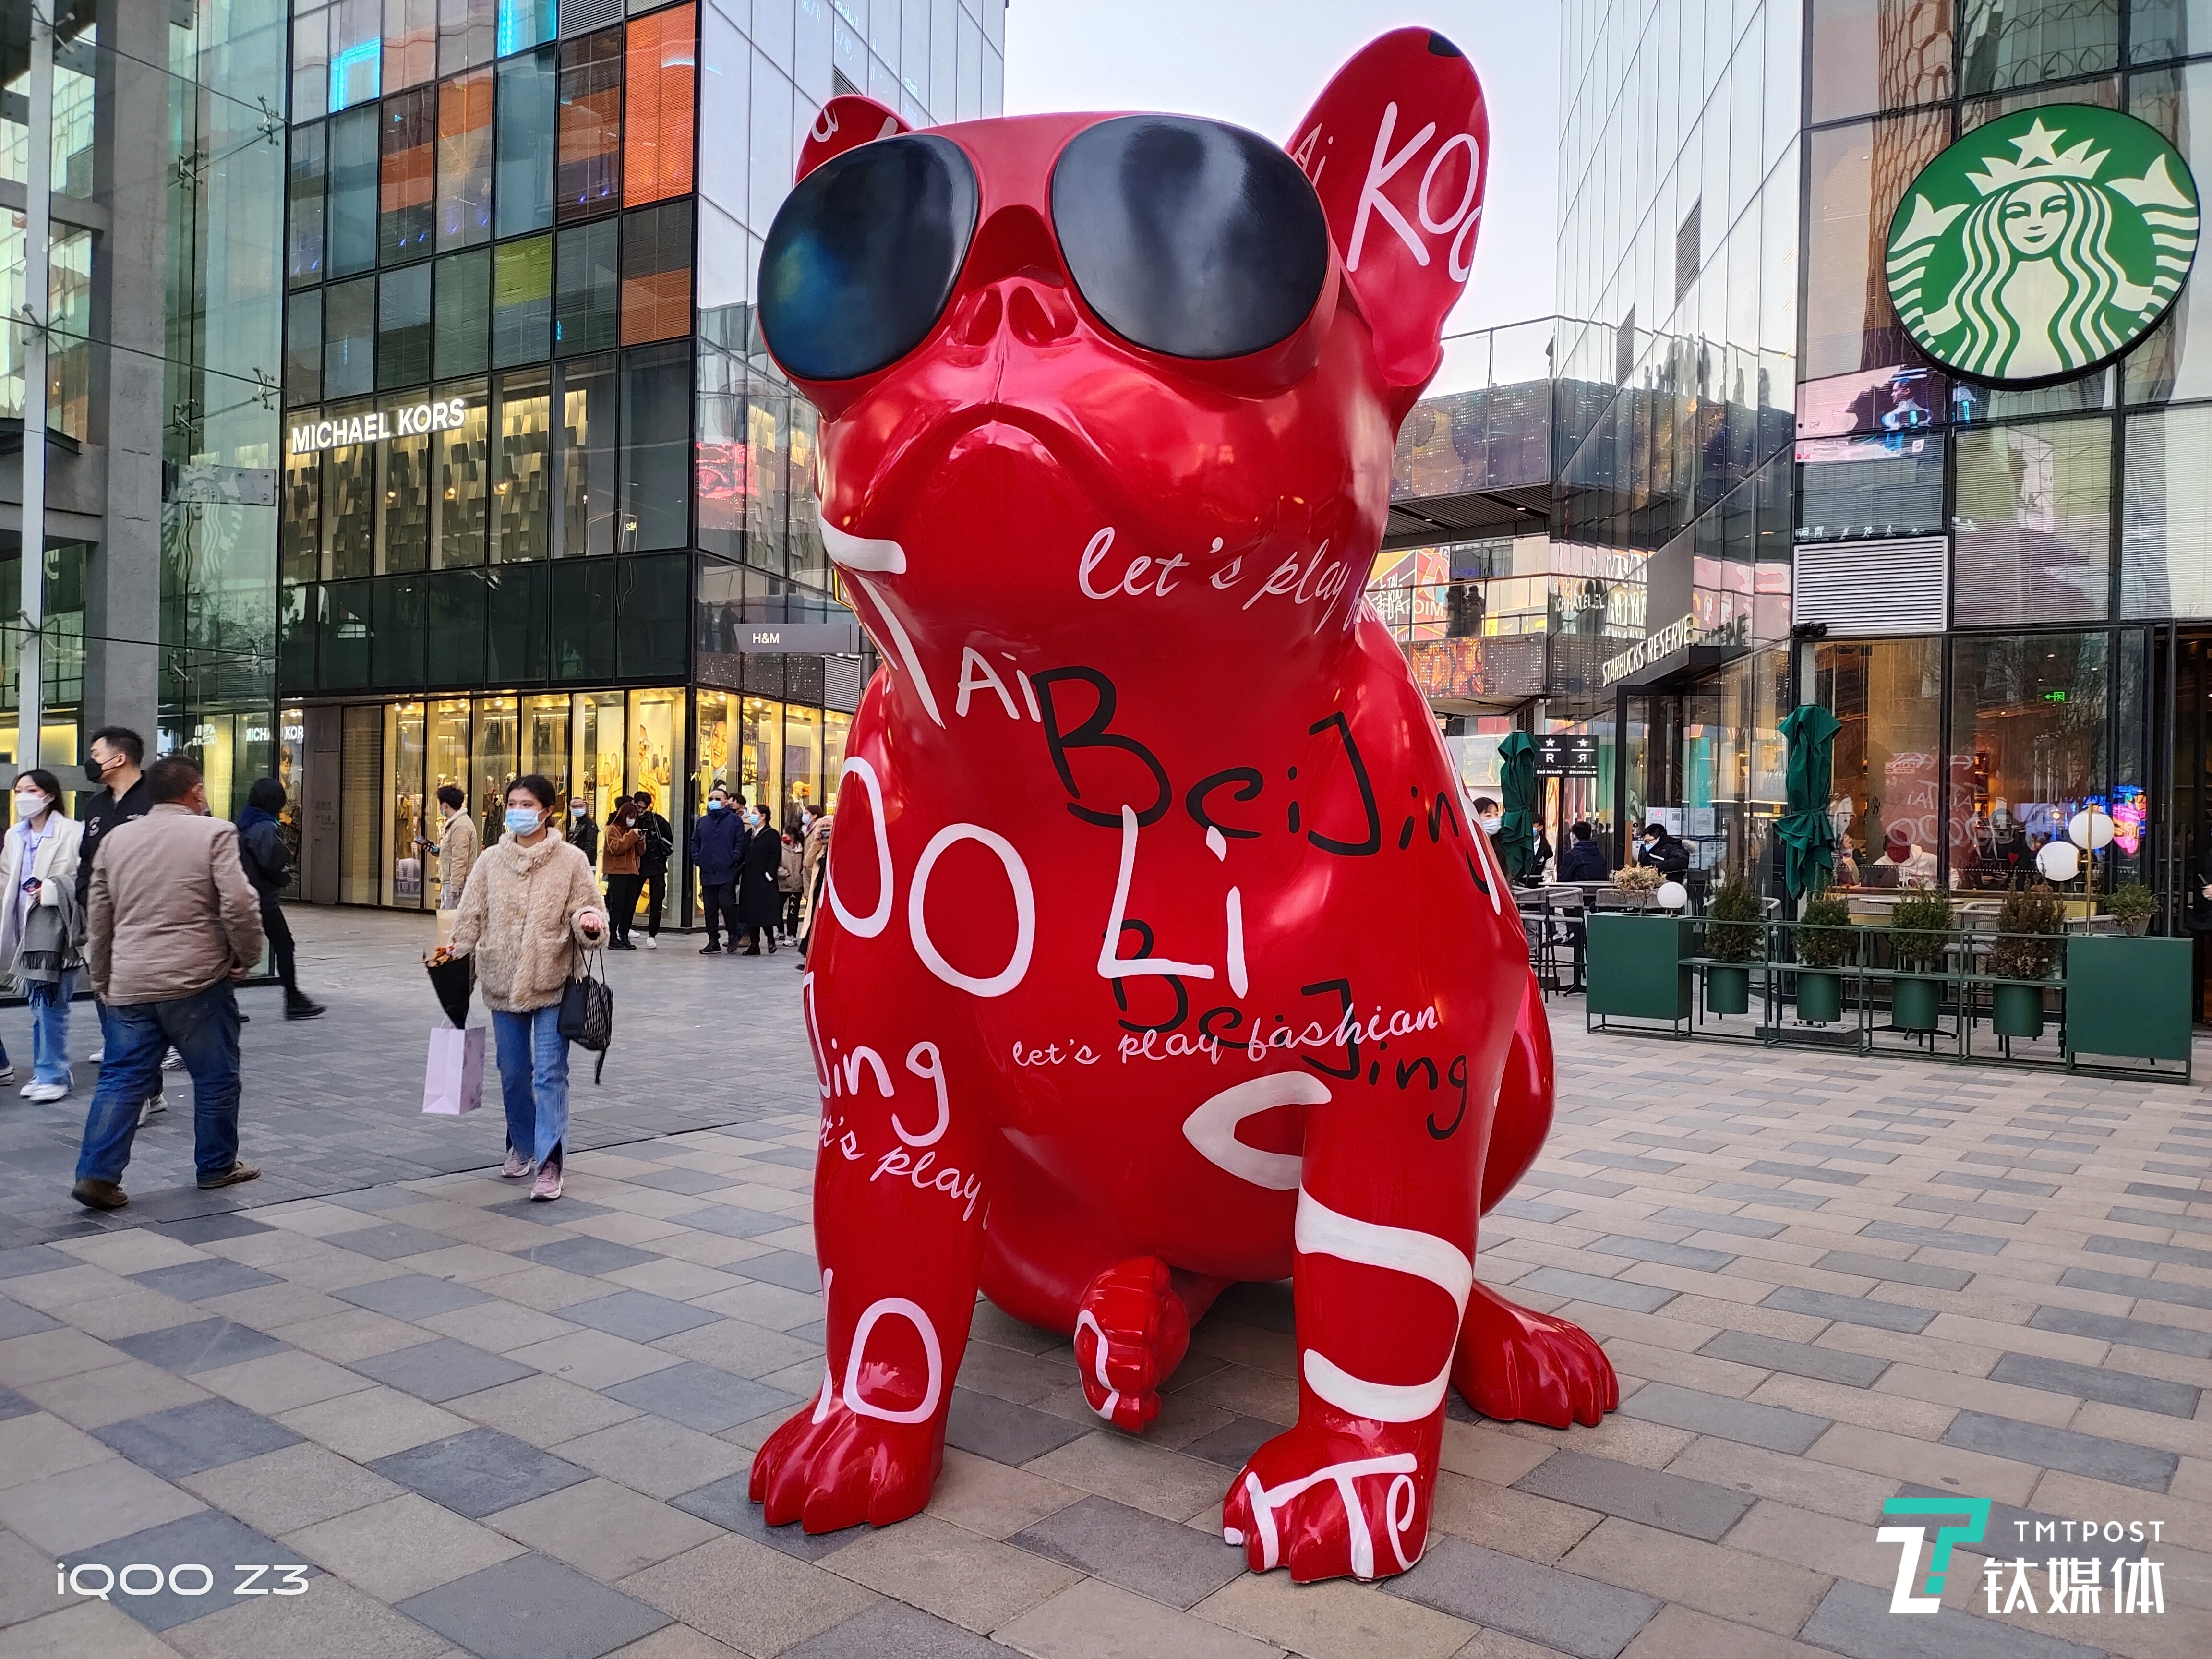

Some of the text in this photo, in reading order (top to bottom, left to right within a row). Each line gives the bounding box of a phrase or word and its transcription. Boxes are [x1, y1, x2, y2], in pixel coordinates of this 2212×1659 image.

[291, 397, 466, 455] MICHAEL KORS
[1242, 538, 1350, 635] play
[752, 632, 780, 644] H&M
[1602, 641, 1645, 688] STARBUCKS
[1647, 614, 1691, 663] RESERVE
[956, 646, 1041, 723] Ai
[1545, 753, 1555, 763] R
[1118, 1029, 1222, 1065] play
[869, 1145, 982, 1222] play
